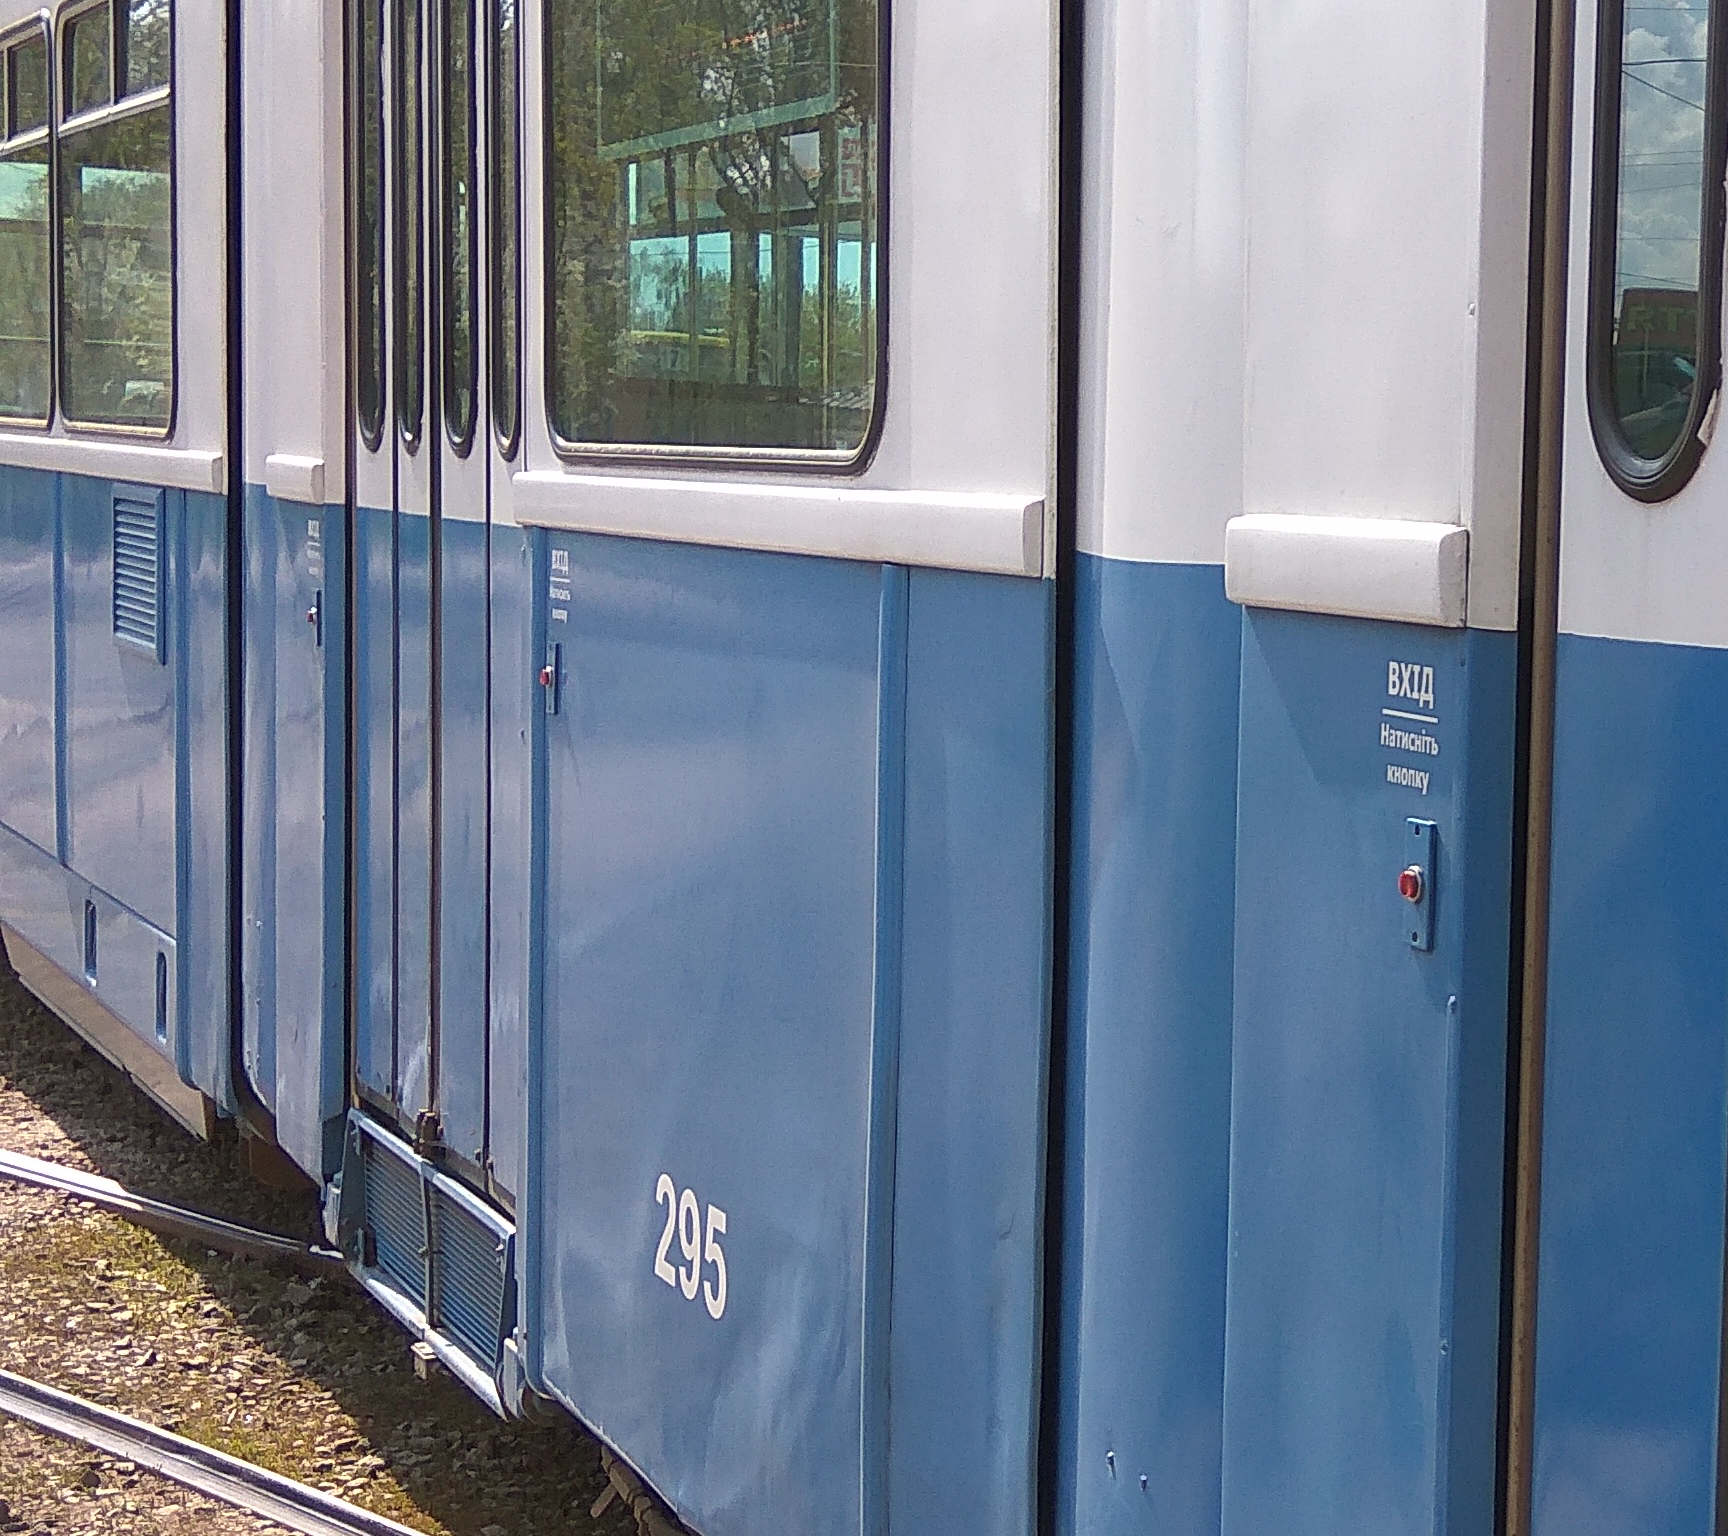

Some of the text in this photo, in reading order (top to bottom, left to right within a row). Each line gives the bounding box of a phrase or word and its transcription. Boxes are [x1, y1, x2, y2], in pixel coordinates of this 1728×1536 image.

[1387, 661, 1434, 709] ВХІД
[1380, 723, 1438, 755] Натисніть
[1386, 764, 1429, 794] кнопку
[654, 1173, 727, 1319] 295
